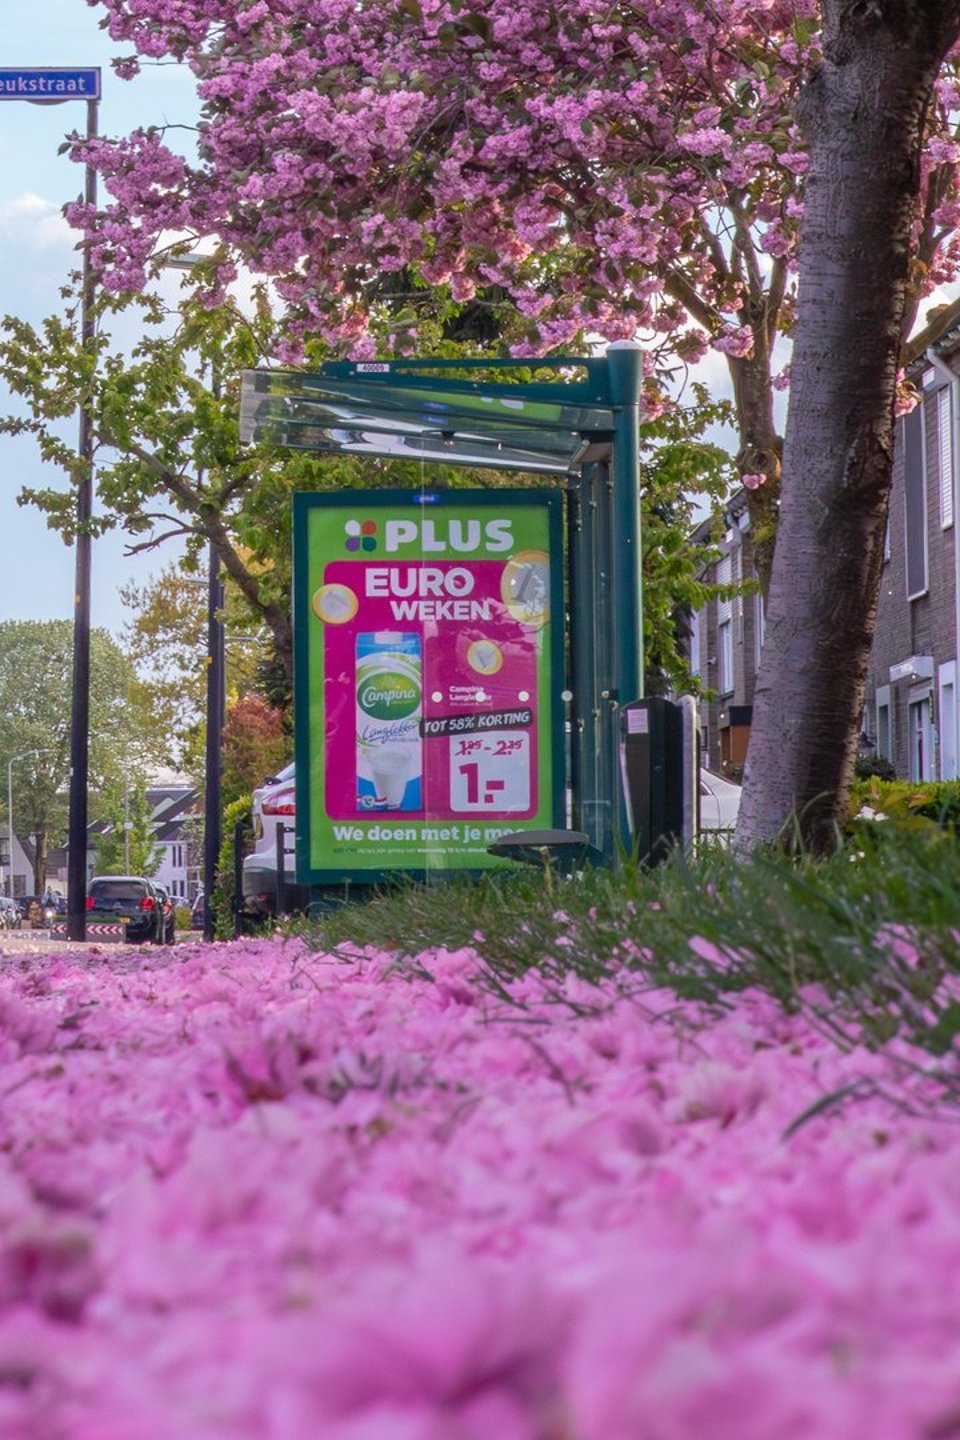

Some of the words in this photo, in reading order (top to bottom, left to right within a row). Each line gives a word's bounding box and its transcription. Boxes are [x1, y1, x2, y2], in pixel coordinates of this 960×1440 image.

[385, 519, 515, 552] PLUS
[365, 567, 475, 597] EURO
[390, 600, 491, 621] WEKEN
[362, 686, 416, 708] Campina
[424, 719, 448, 733] TOT
[449, 716, 475, 730] 58%
[478, 711, 530, 728] KORTING
[333, 826, 364, 841] We
[368, 826, 417, 841] doen
[421, 826, 460, 841] met
[463, 825, 481, 843] je
